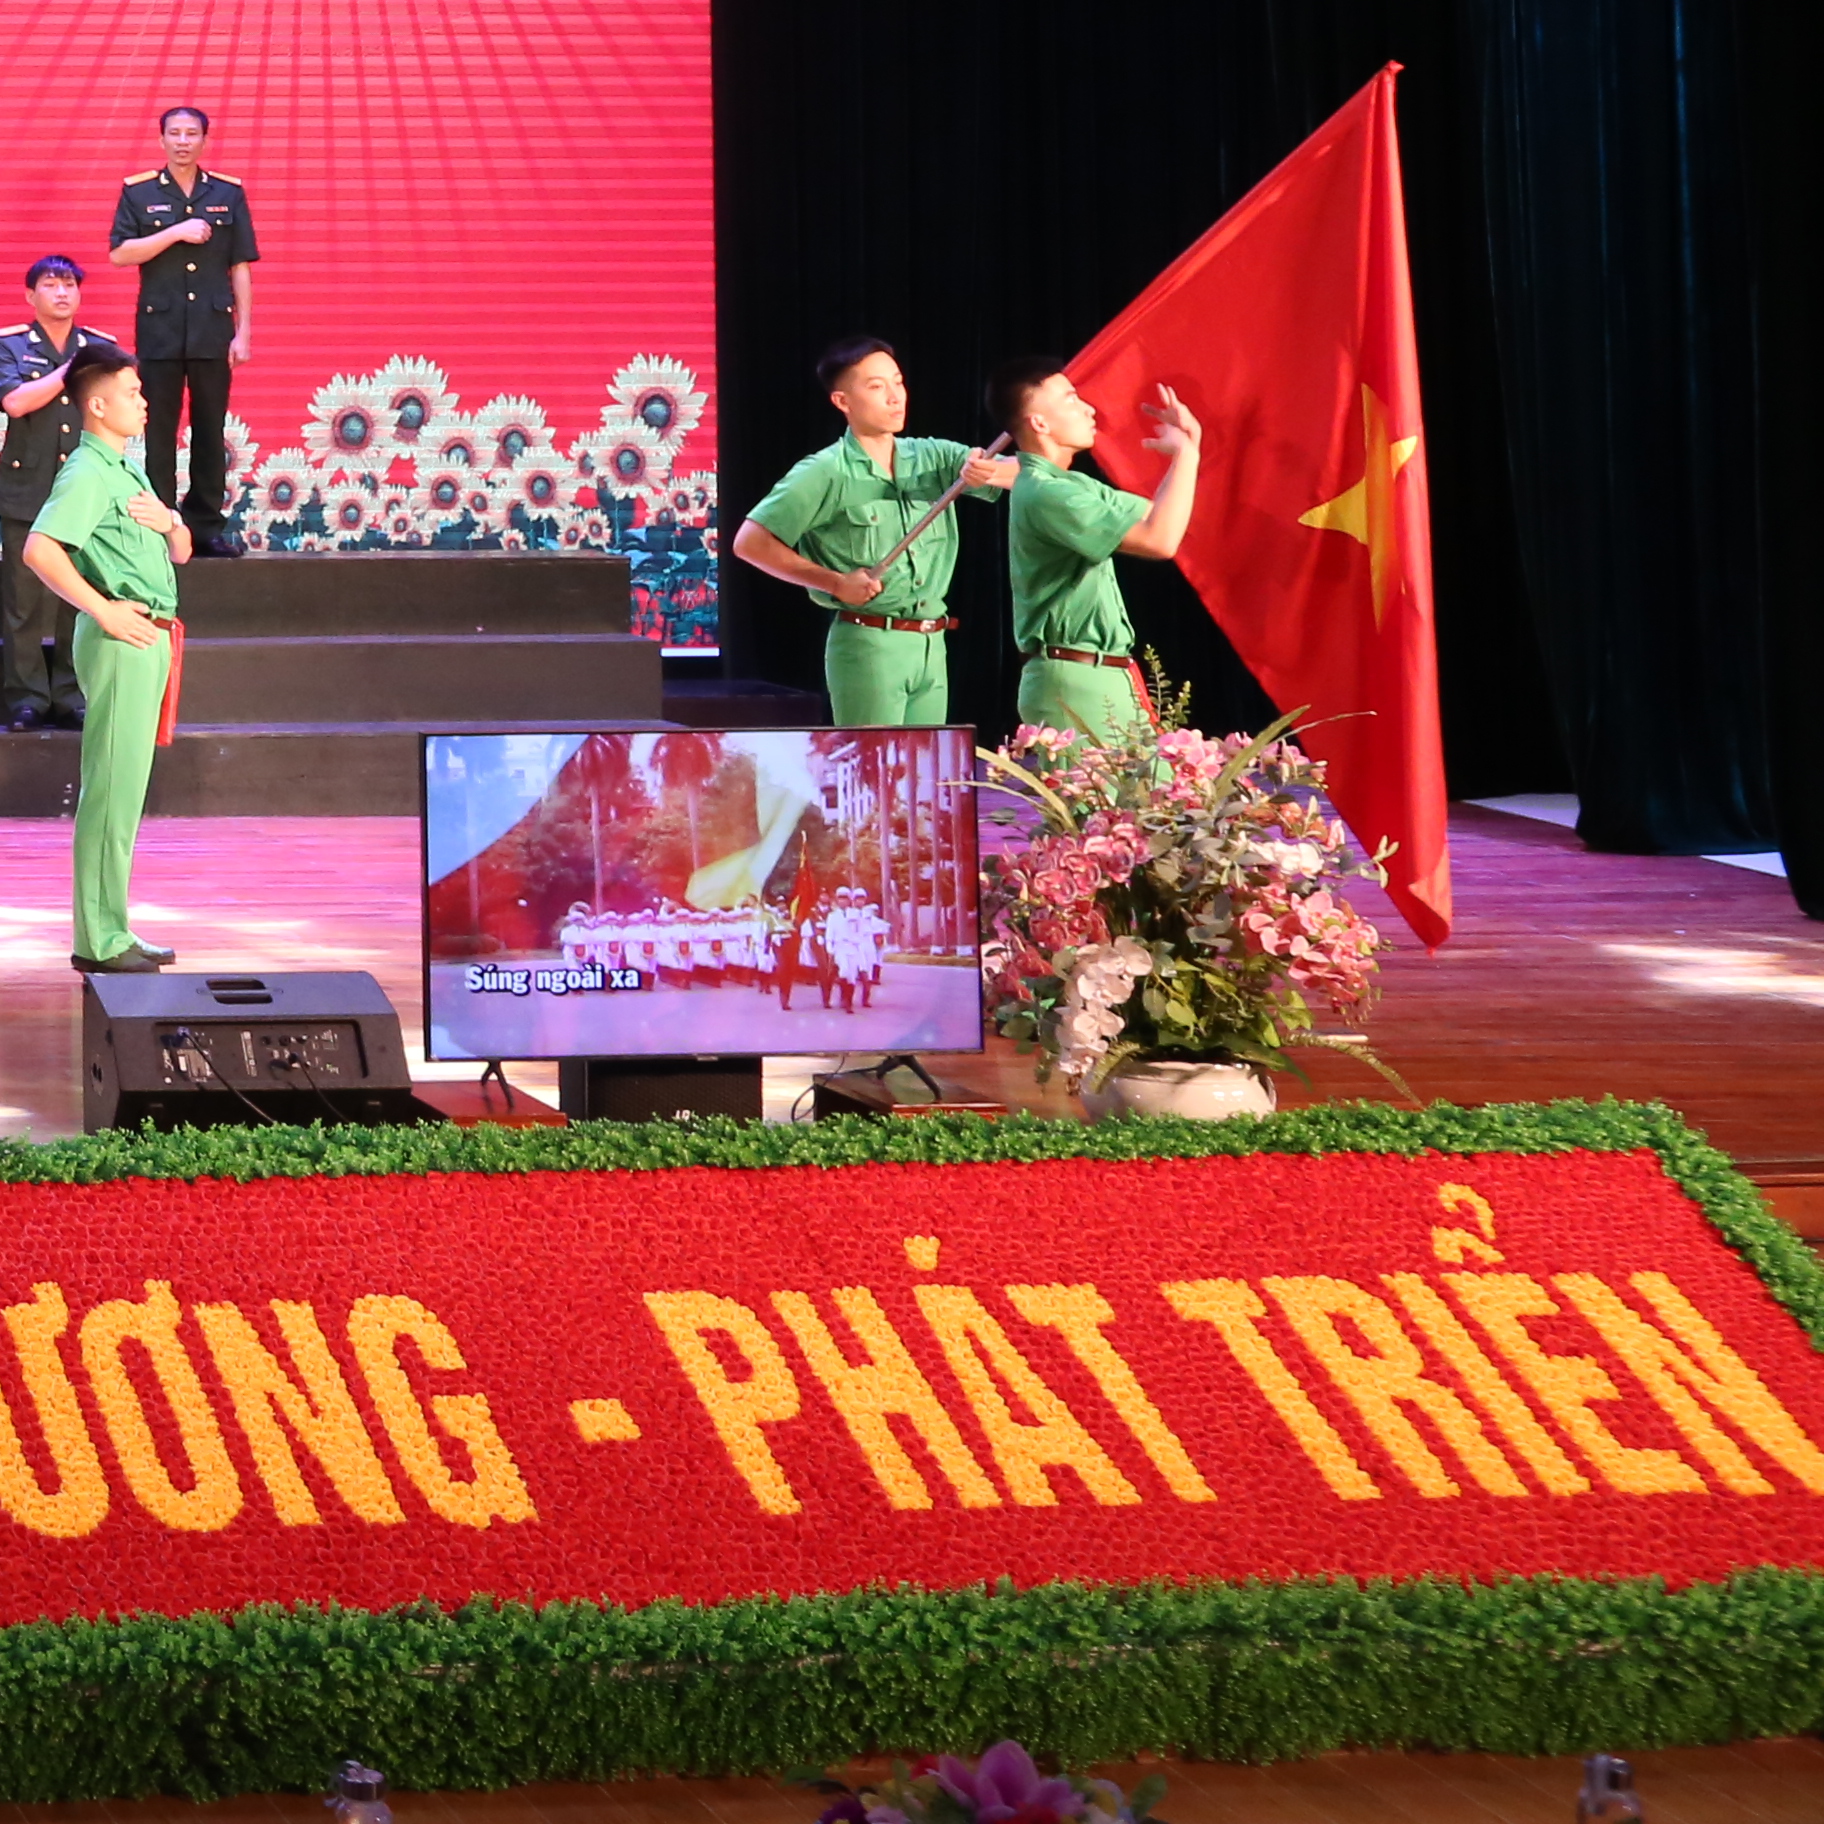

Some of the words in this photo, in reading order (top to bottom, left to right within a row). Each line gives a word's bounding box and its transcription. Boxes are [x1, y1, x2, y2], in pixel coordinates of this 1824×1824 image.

[465, 964, 529, 994] Súng
[536, 964, 602, 994] ngoài
[610, 969, 639, 988] xa
[642, 1235, 1218, 1515] PHÁT
[1160, 1182, 1824, 1501] TRIỂN
